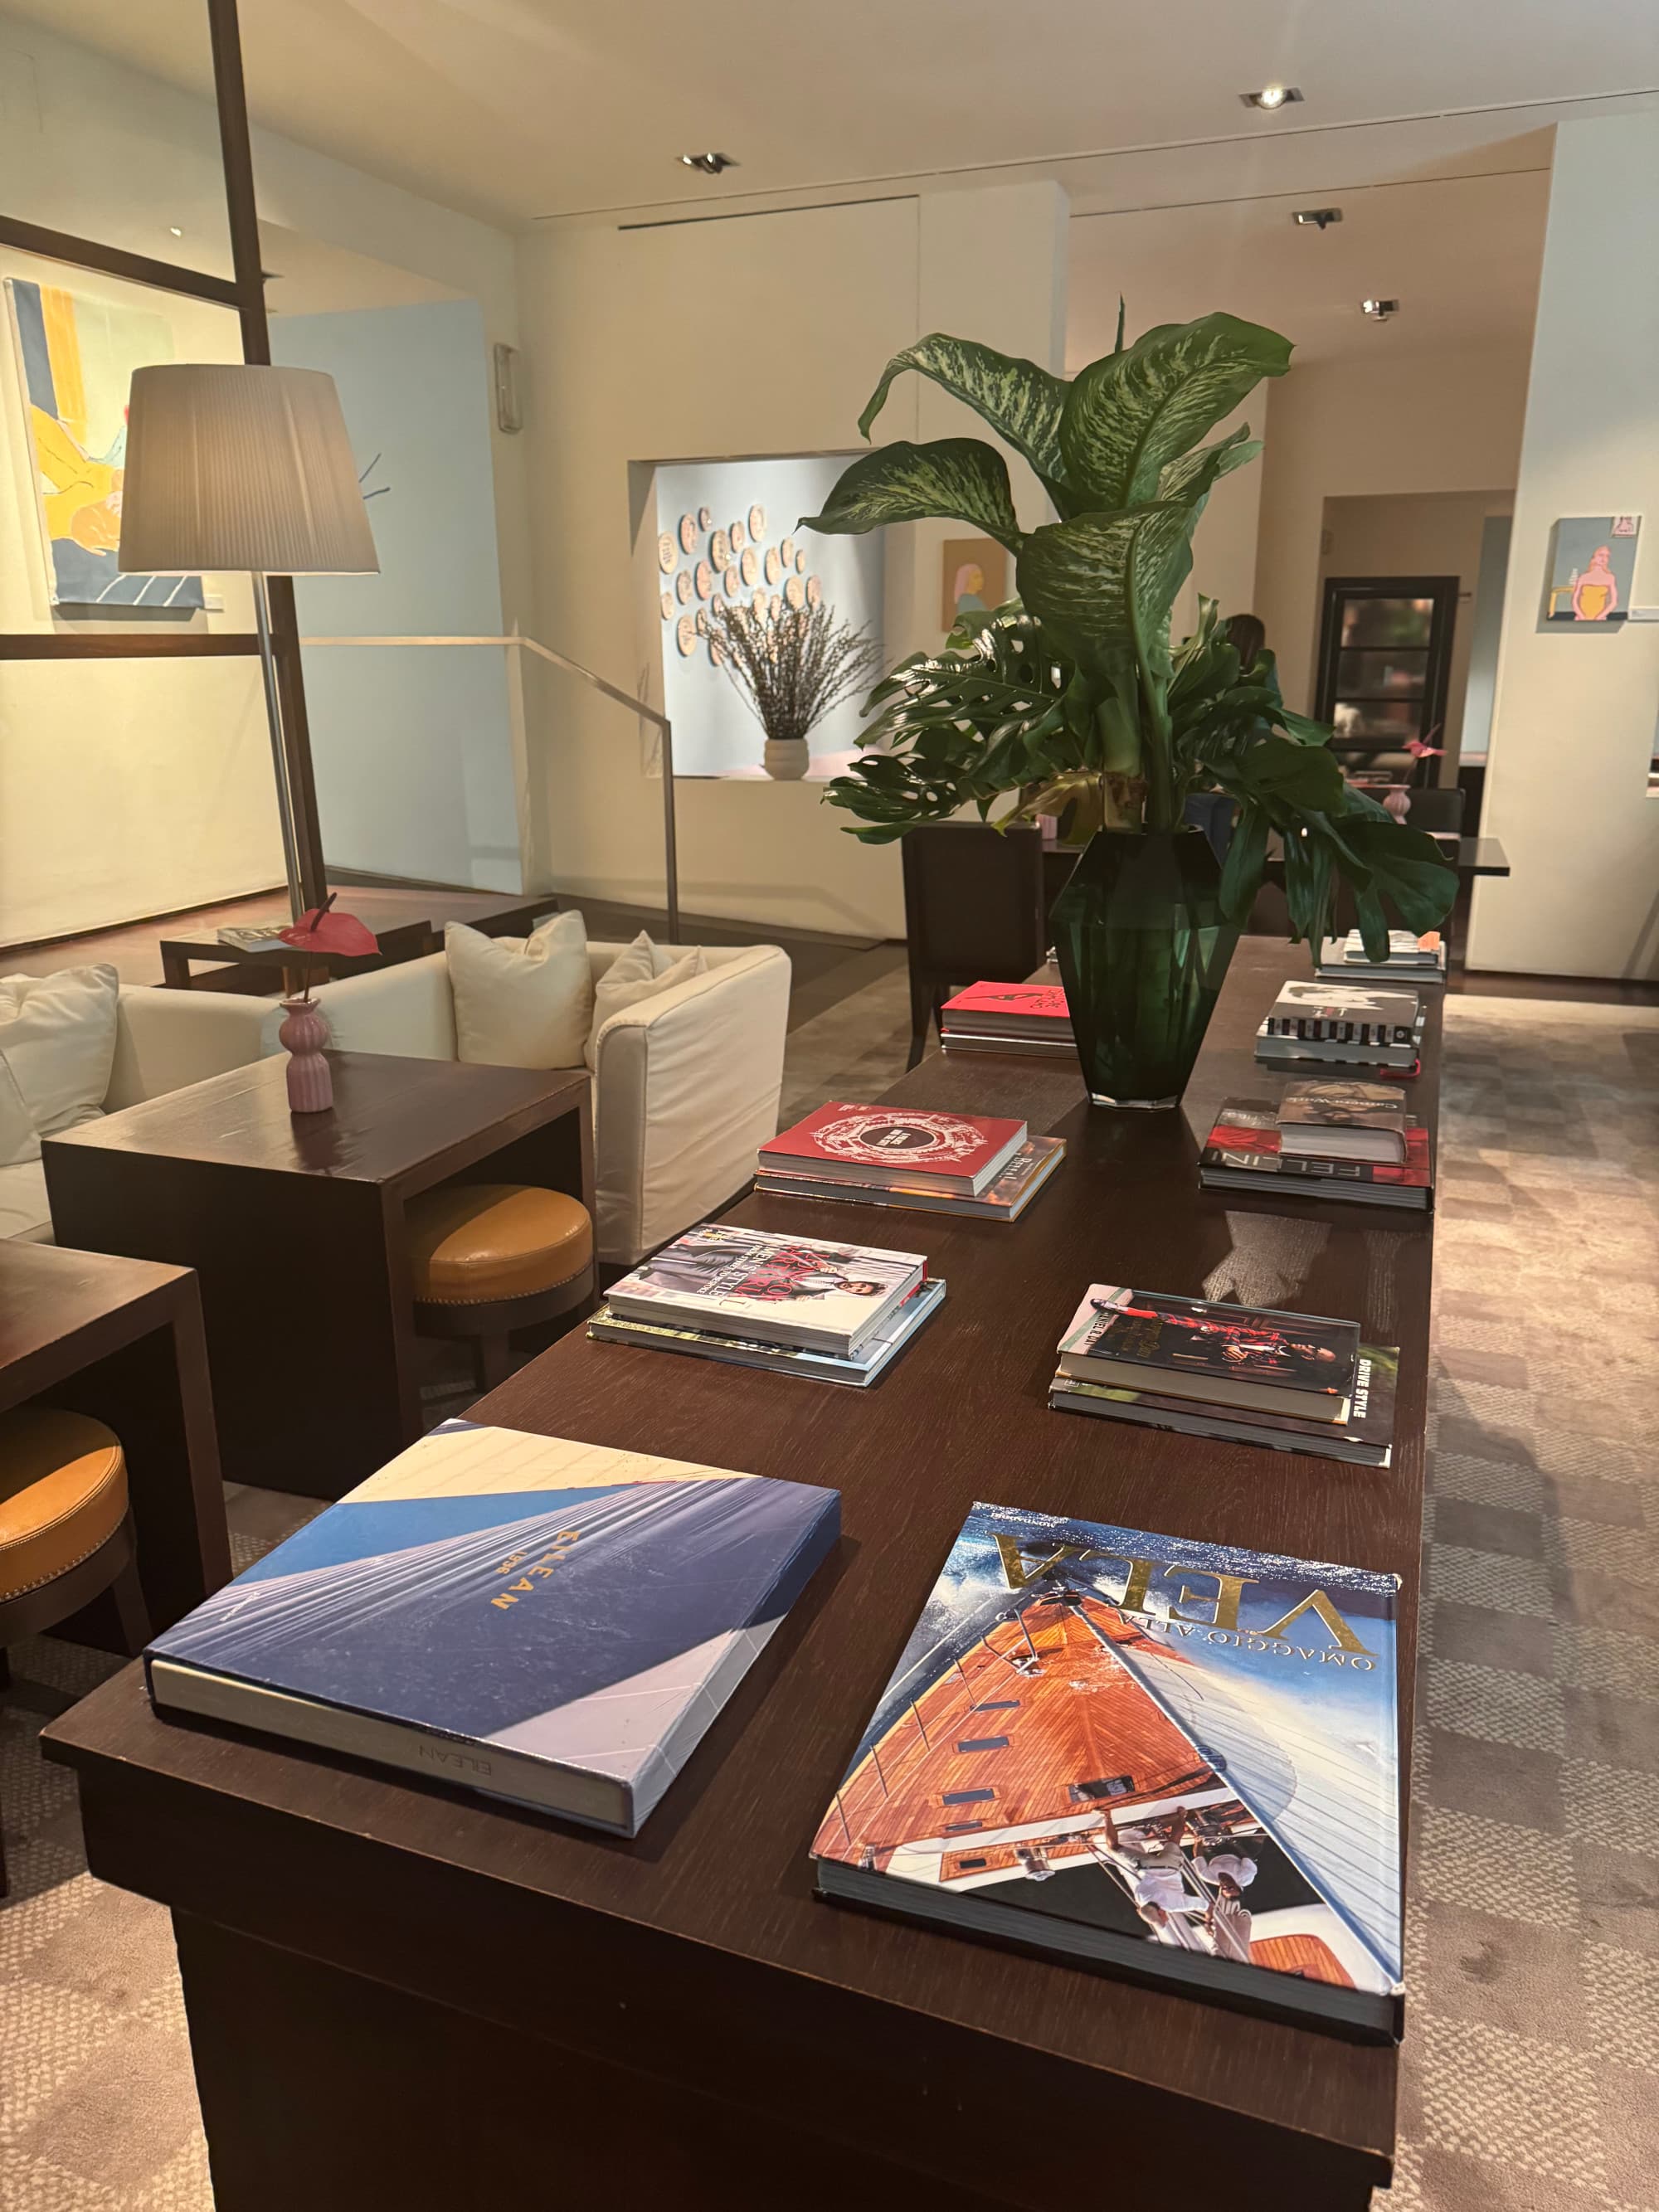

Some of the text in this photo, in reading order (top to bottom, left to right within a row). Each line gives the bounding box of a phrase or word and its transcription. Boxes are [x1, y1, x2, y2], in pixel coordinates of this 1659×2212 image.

[1212, 1152, 1360, 1177] FELLINI
[706, 1271, 750, 1296] STYLE
[1353, 1359, 1372, 1418] DRIVE STYLE
[490, 1530, 580, 1610] EILEAN
[990, 1532, 1379, 1656] VELA
[1117, 1609, 1376, 1671] OMAGGIO ALLA
[419, 1745, 492, 1777] EILEAN
